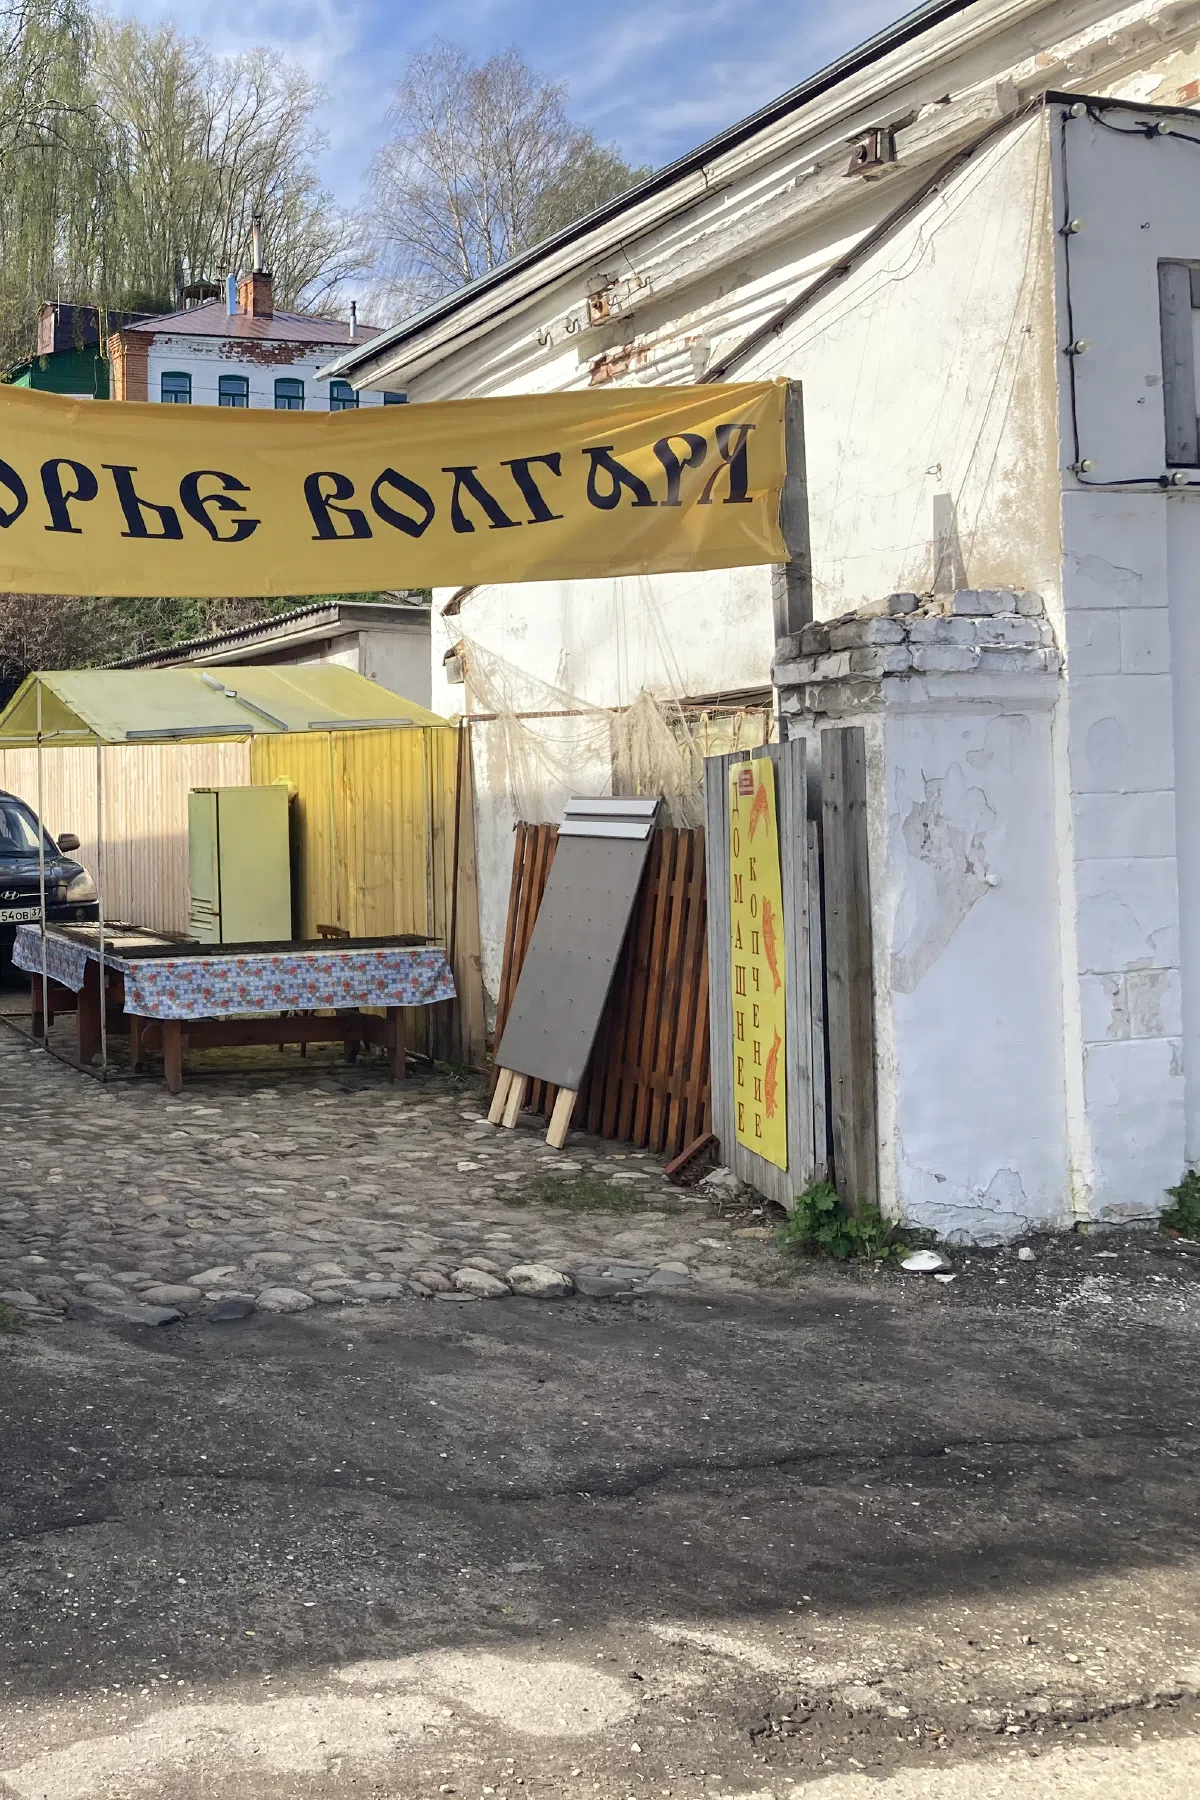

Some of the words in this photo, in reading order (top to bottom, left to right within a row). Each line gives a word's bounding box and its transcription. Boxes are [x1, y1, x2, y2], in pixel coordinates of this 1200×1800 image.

[303, 423, 757, 541] ВОЛГАРЯ
[732, 782, 746, 1133] ДОМАШНЕЕ
[749, 857, 762, 1138] КОПЧЕНИЕ
